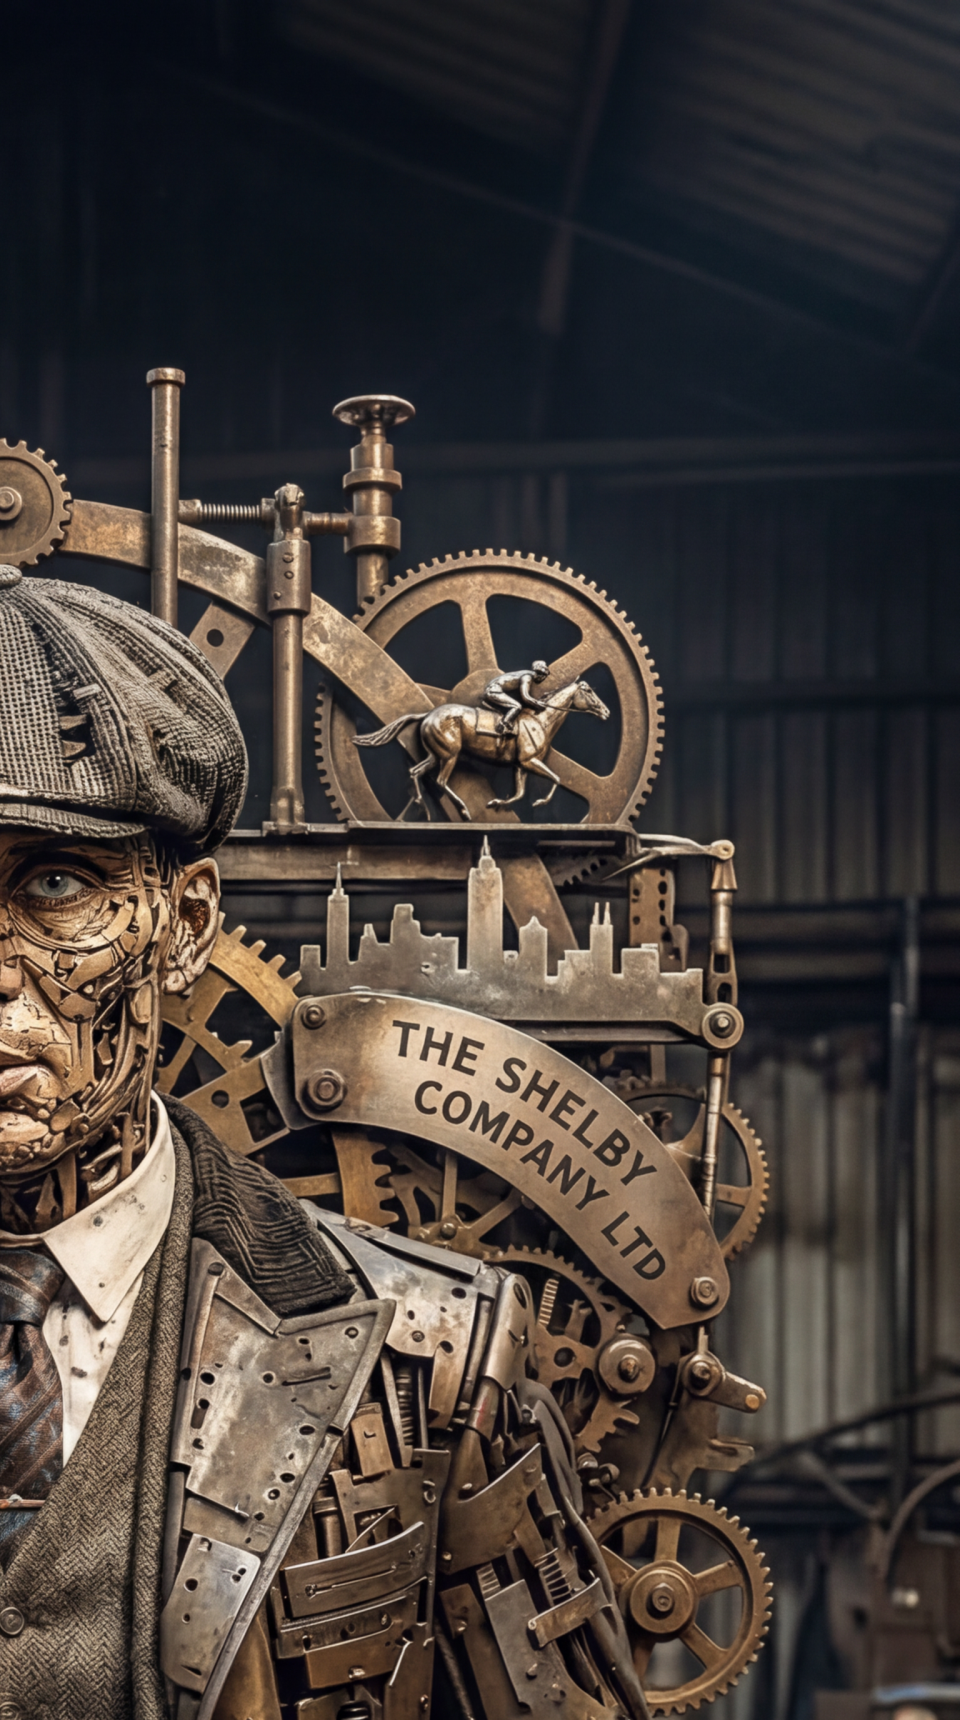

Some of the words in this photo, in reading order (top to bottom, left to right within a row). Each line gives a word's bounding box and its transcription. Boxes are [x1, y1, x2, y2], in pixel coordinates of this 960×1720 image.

[392, 1020, 485, 1076] THE
[495, 1057, 657, 1187] SHELBY
[414, 1080, 610, 1211] COMPANY
[600, 1211, 666, 1280] LTD
